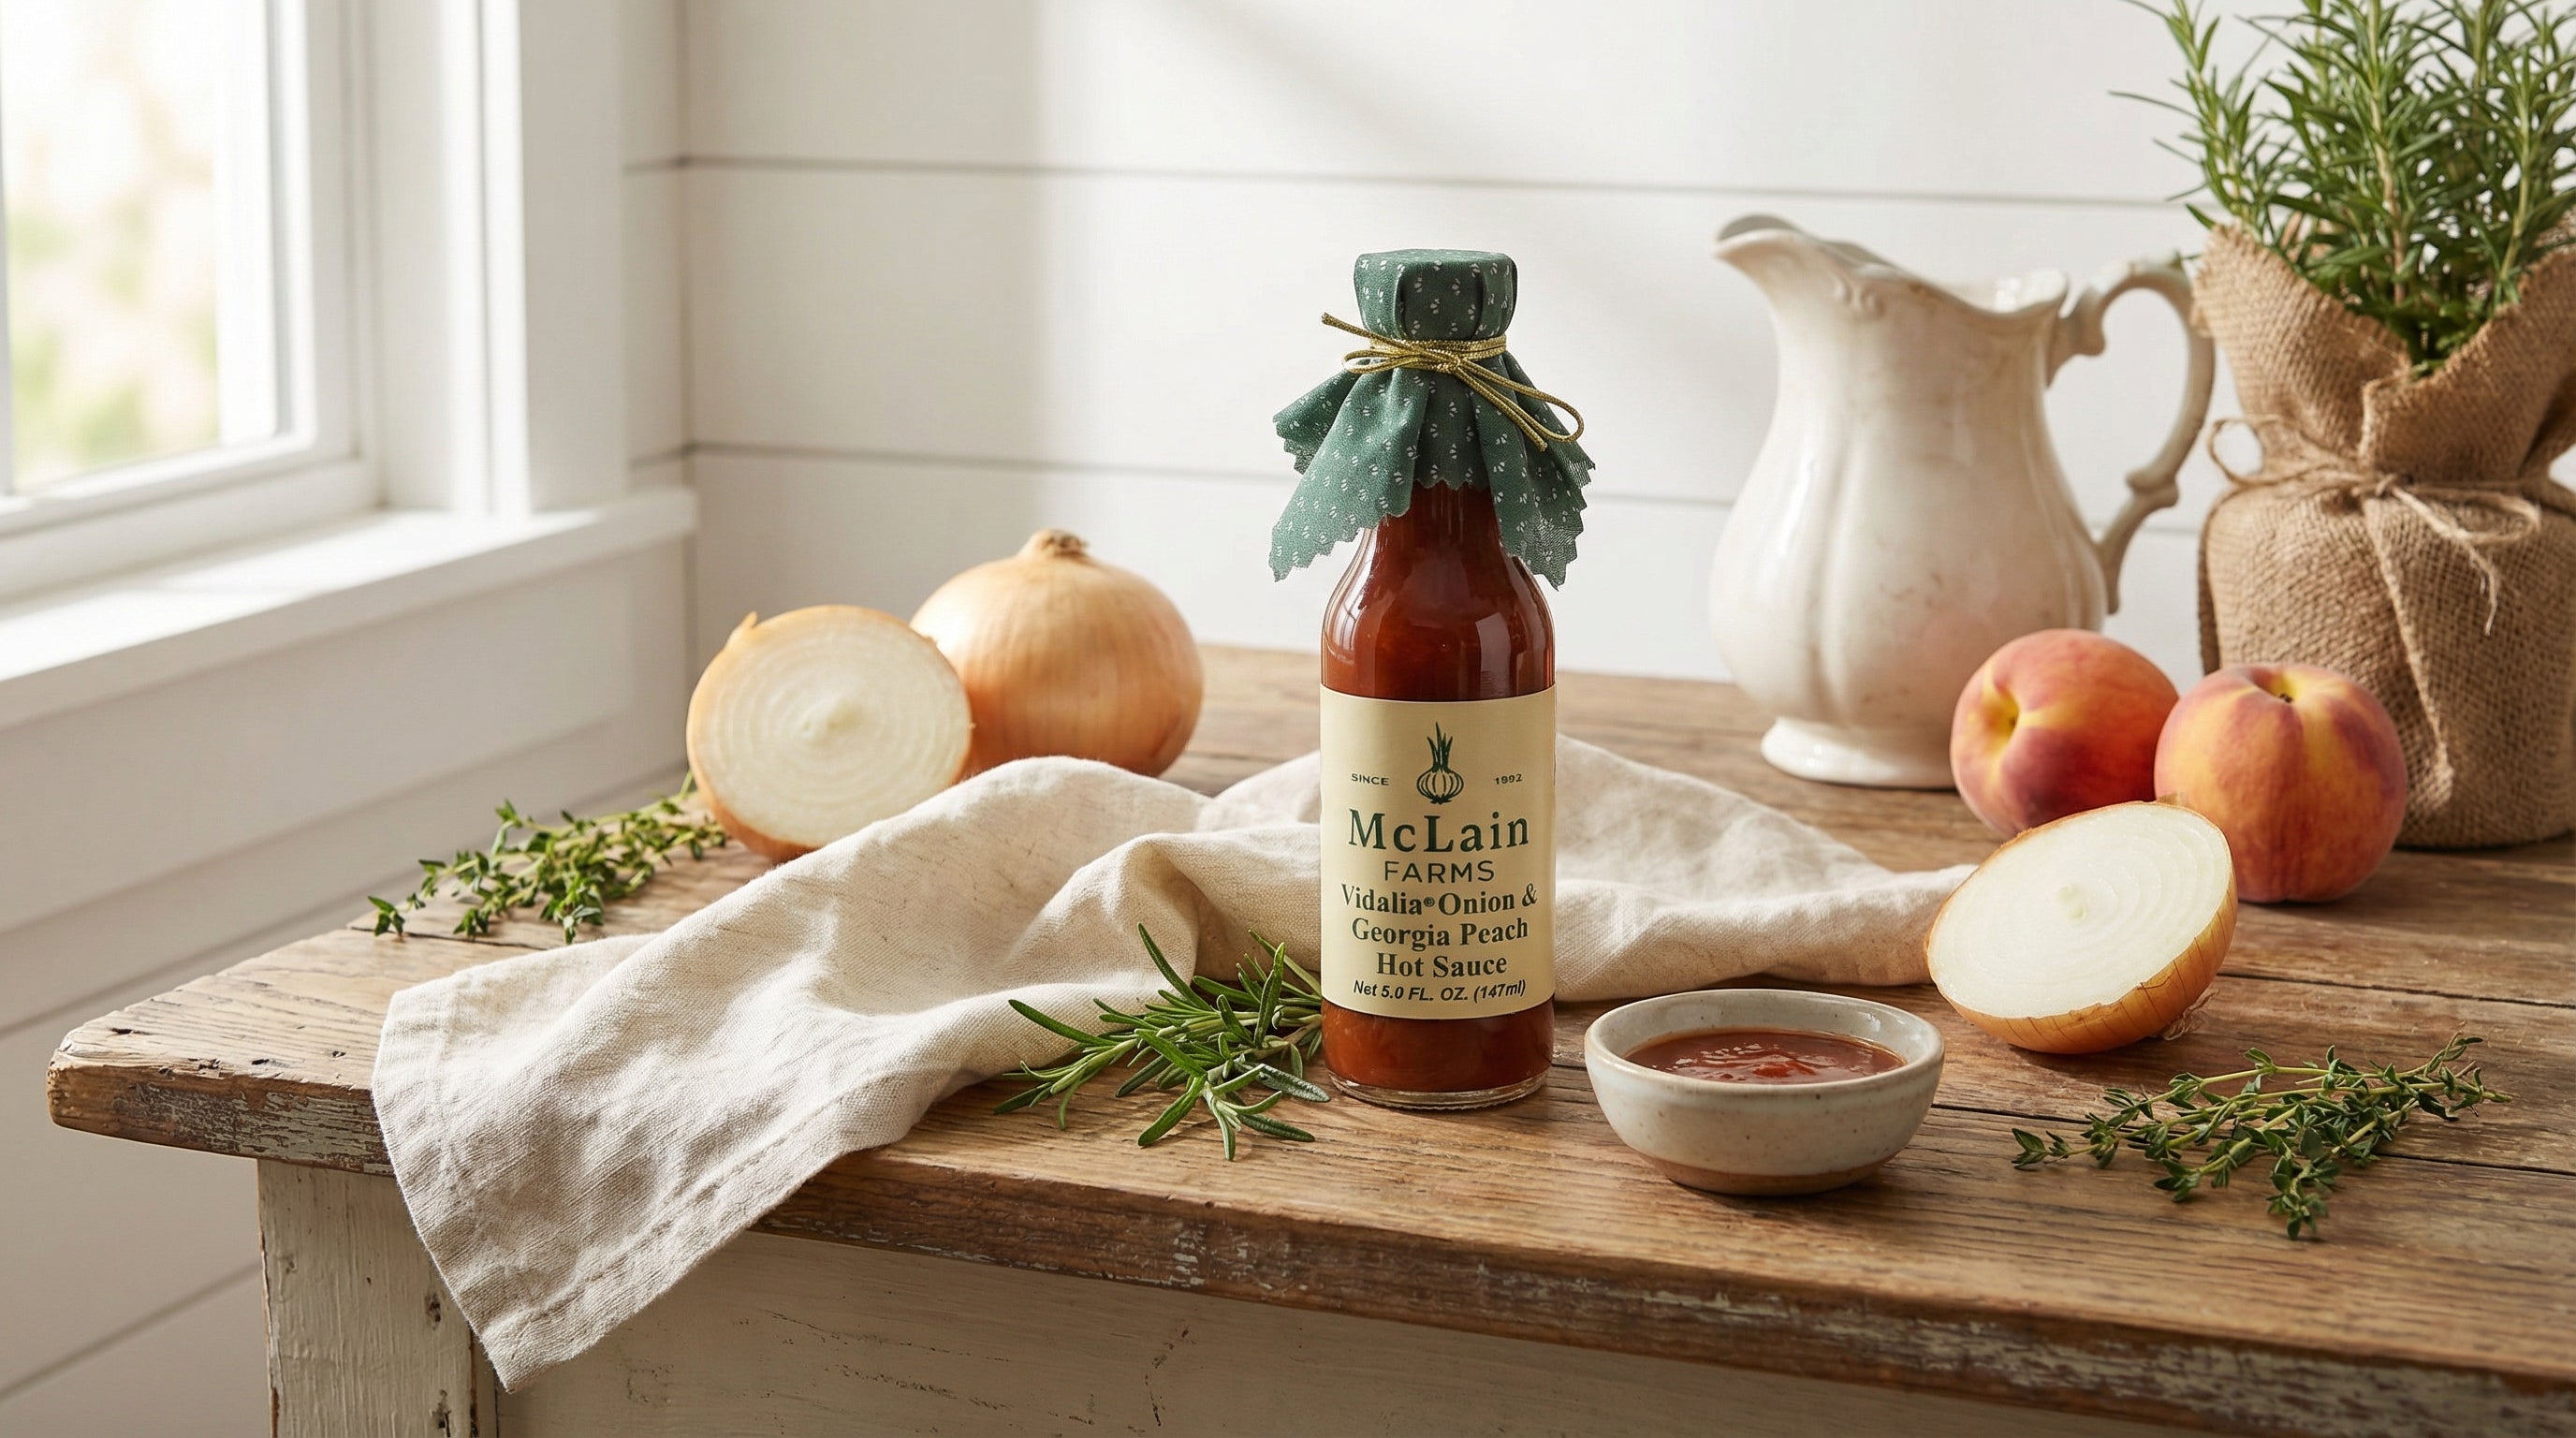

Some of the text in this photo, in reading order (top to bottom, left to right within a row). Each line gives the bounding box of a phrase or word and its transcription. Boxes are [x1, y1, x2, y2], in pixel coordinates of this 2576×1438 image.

[1351, 772, 1390, 786] SINCE
[1348, 808, 1530, 853] McLain
[1384, 859, 1495, 884] FARMS
[1438, 890, 1515, 916] Onion
[1521, 882, 1538, 908] &
[1352, 917, 1529, 953] Georgia Peach
[1376, 951, 1508, 978] Hot Sauce
[1353, 978, 1527, 1005] Net 5.0 FL. OZ. (147ml)
